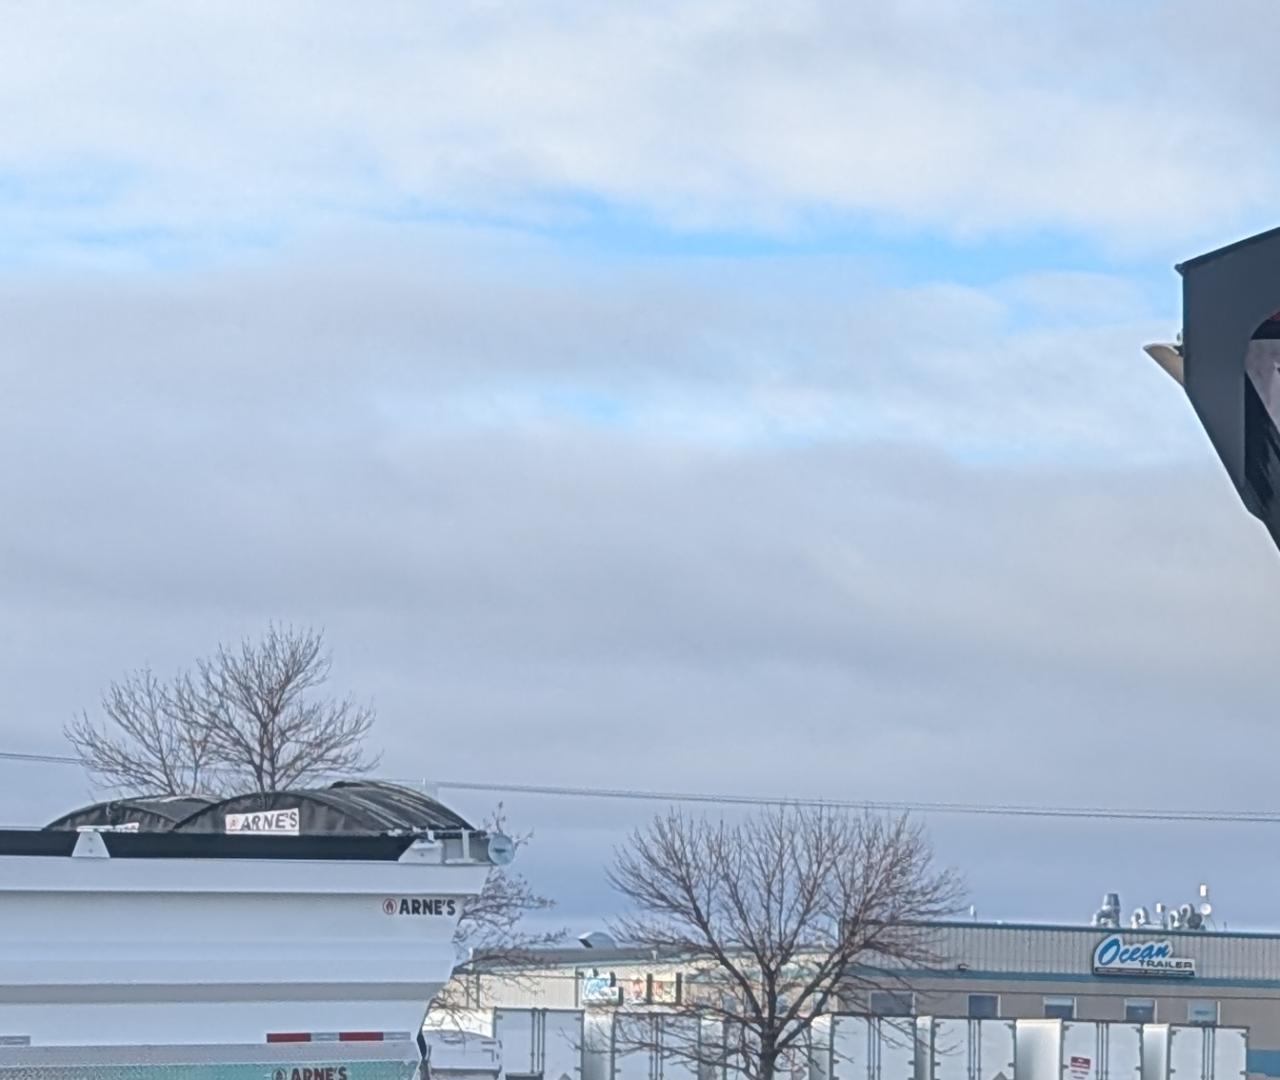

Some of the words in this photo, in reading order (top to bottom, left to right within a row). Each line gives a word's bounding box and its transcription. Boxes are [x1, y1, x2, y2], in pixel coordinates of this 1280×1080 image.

[240, 811, 298, 831] ARNE'S
[398, 898, 456, 916] ARNE'S
[1098, 938, 1170, 965] Ocean
[1139, 960, 1193, 969] TRAILER
